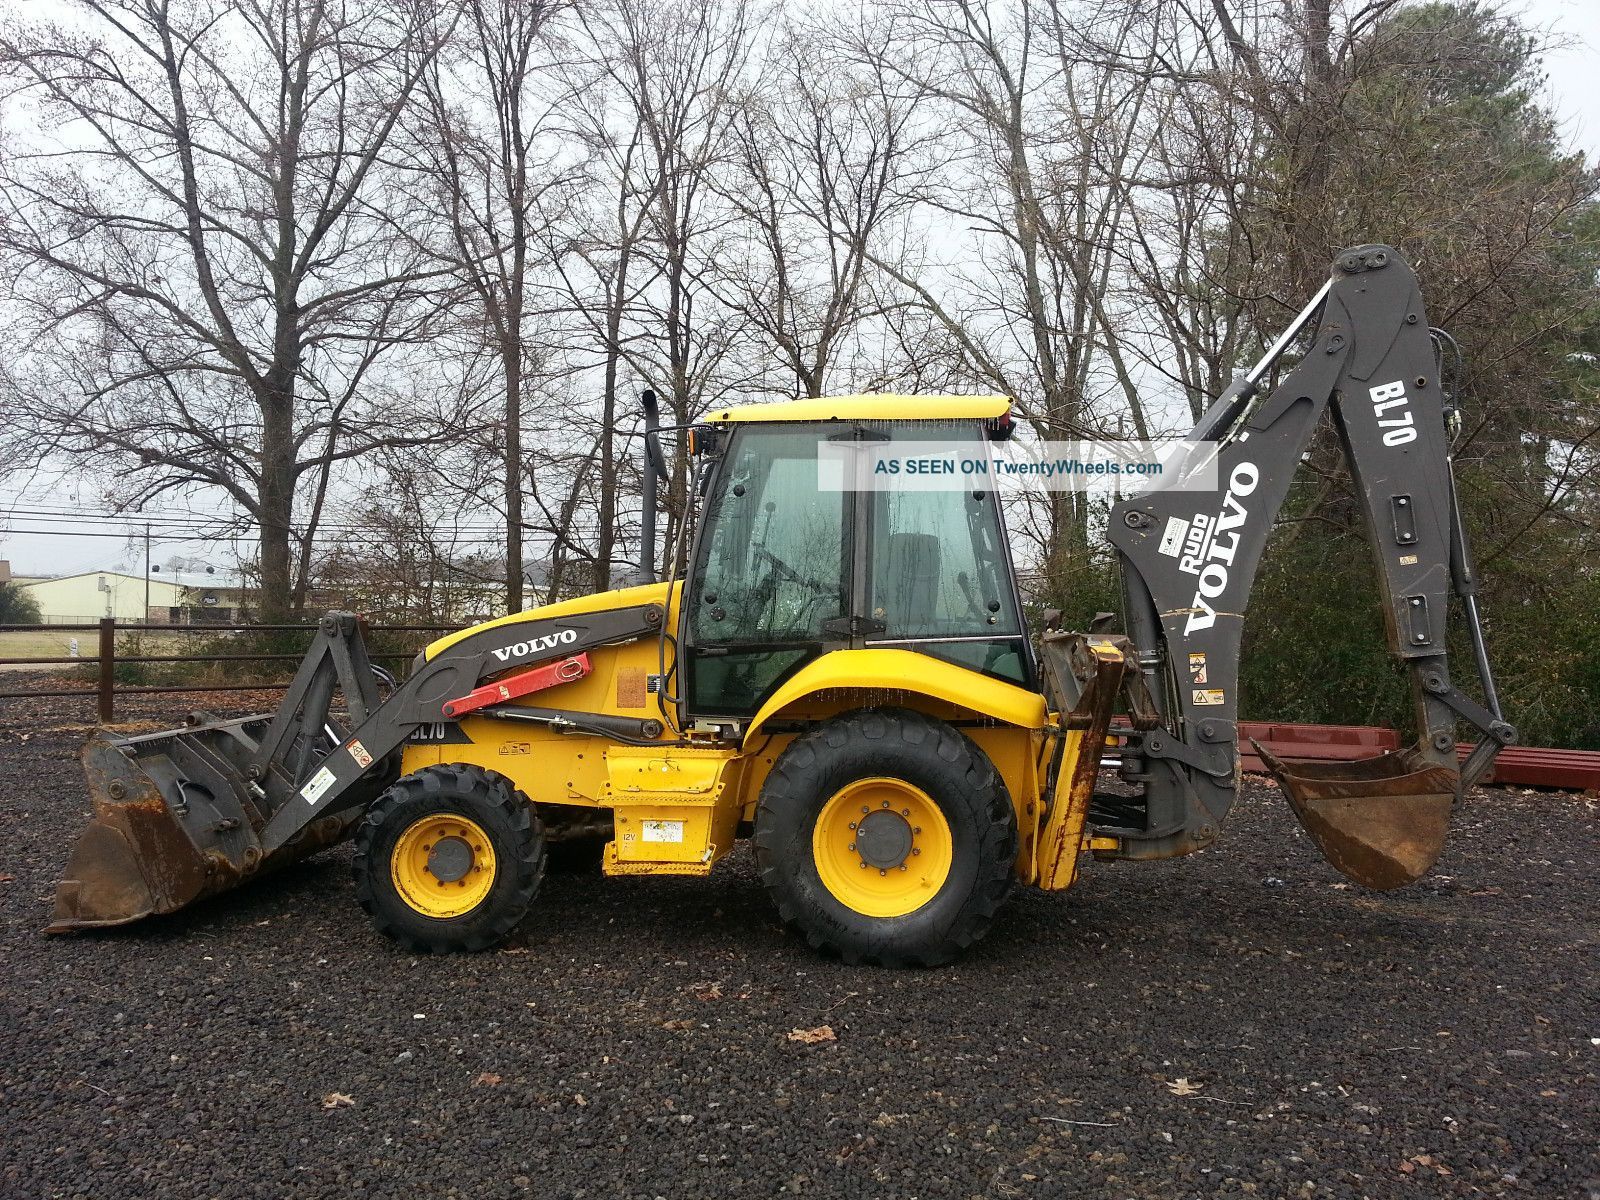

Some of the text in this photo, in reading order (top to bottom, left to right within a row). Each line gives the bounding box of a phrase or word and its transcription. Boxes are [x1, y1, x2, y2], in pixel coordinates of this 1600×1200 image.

[1368, 379, 1418, 447] BL70
[1178, 513, 1209, 576] RUDD
[1183, 461, 1260, 637] VOLVO
[491, 629, 578, 662] VOLVO
